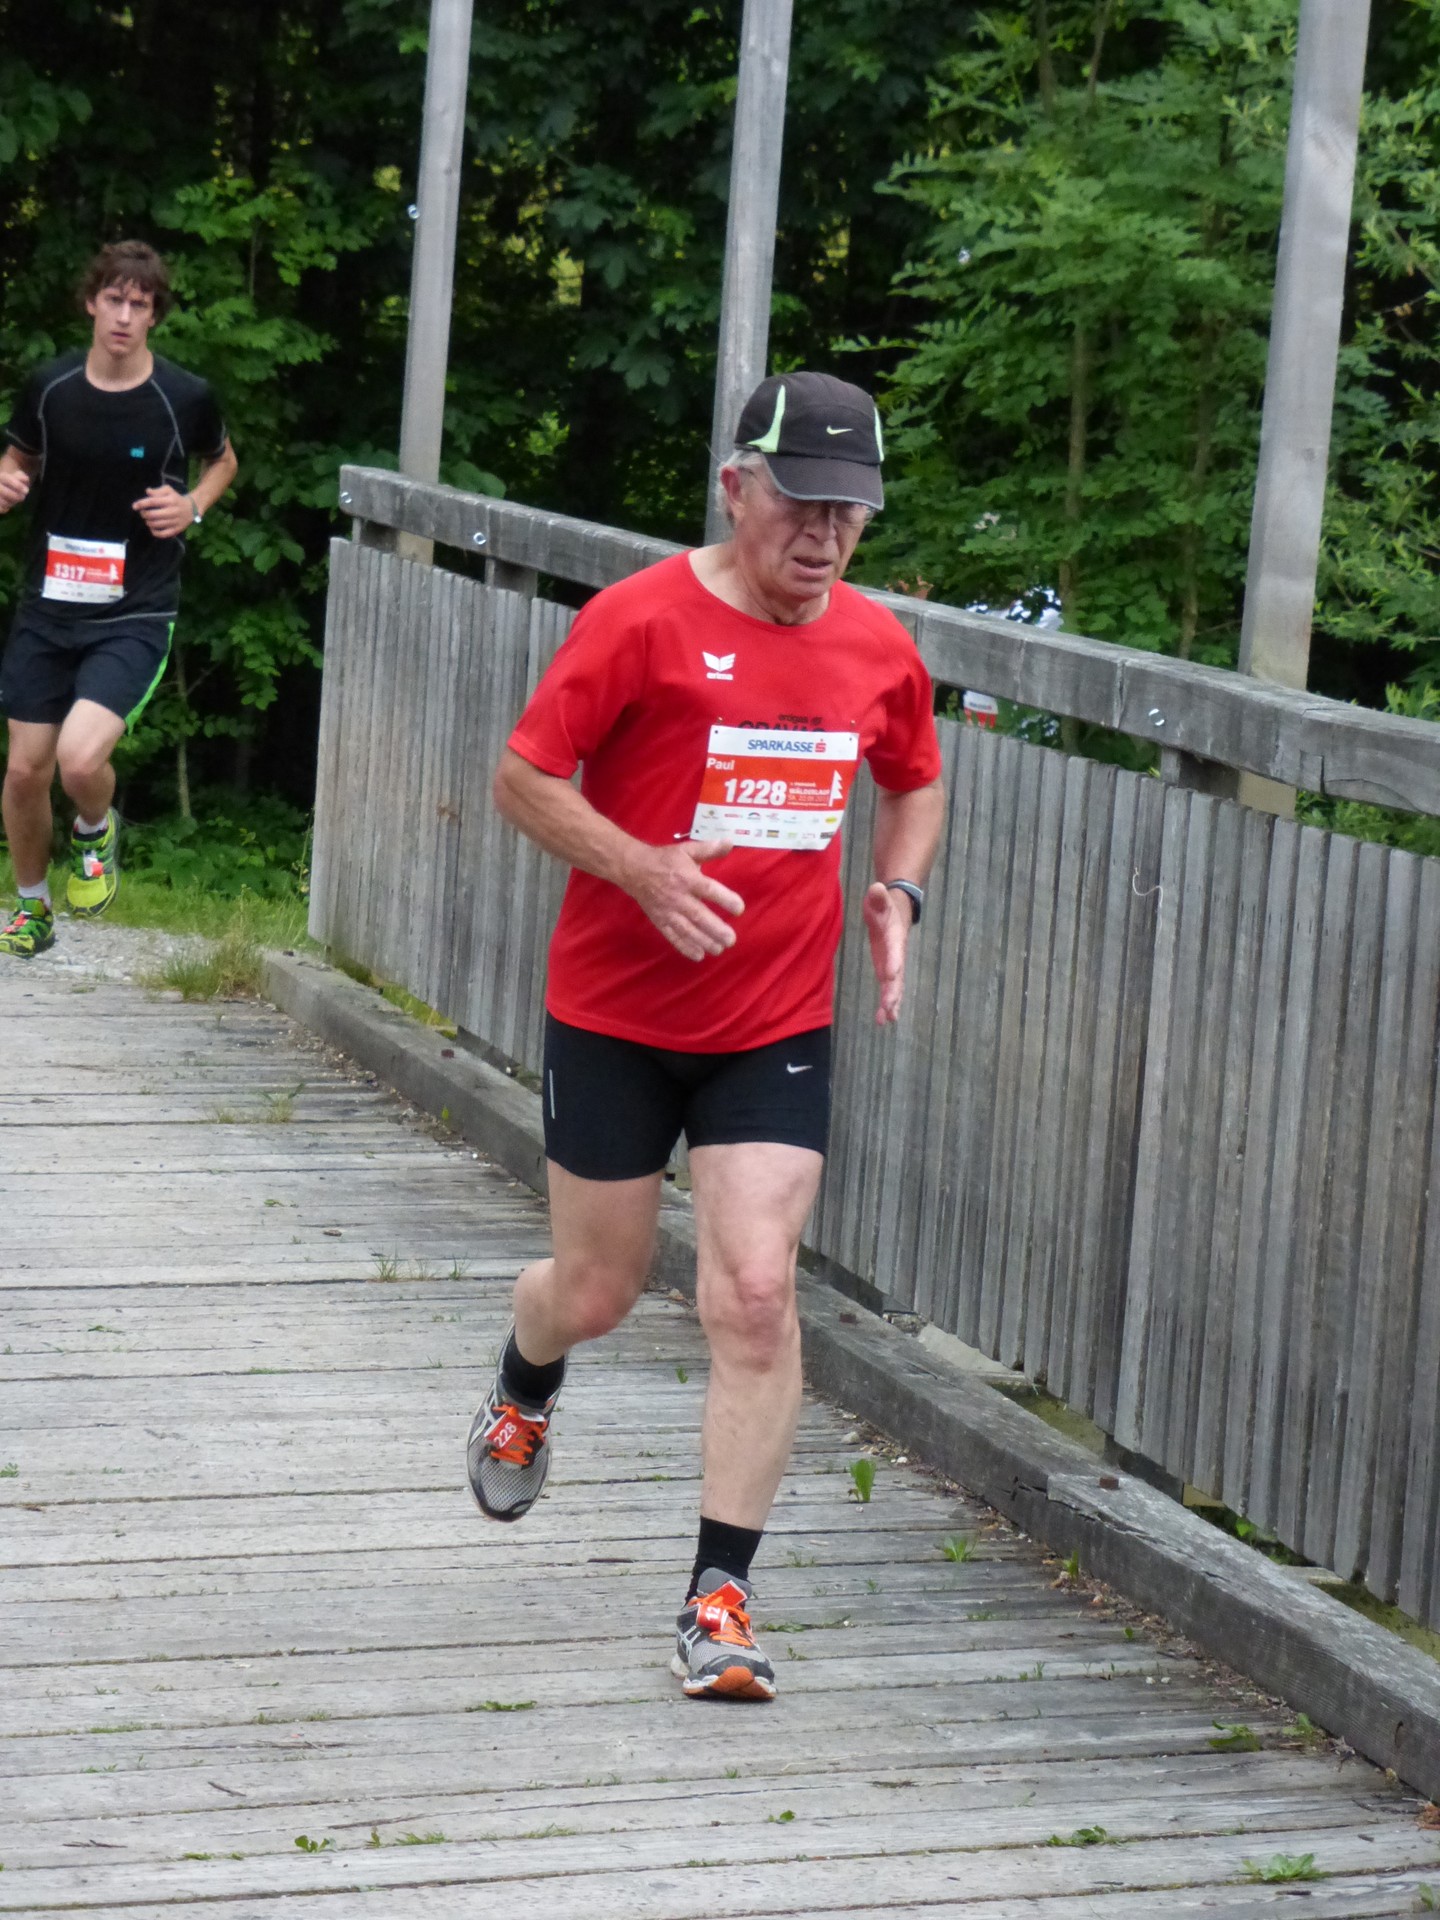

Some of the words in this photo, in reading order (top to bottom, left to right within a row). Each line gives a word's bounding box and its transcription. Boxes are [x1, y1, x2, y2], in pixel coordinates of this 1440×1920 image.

[54, 563, 86, 580] 1317
[748, 739, 814, 753] SPARKASSE
[706, 758, 735, 770] Paul
[725, 778, 787, 806] 1228
[494, 1422, 516, 1447] 228
